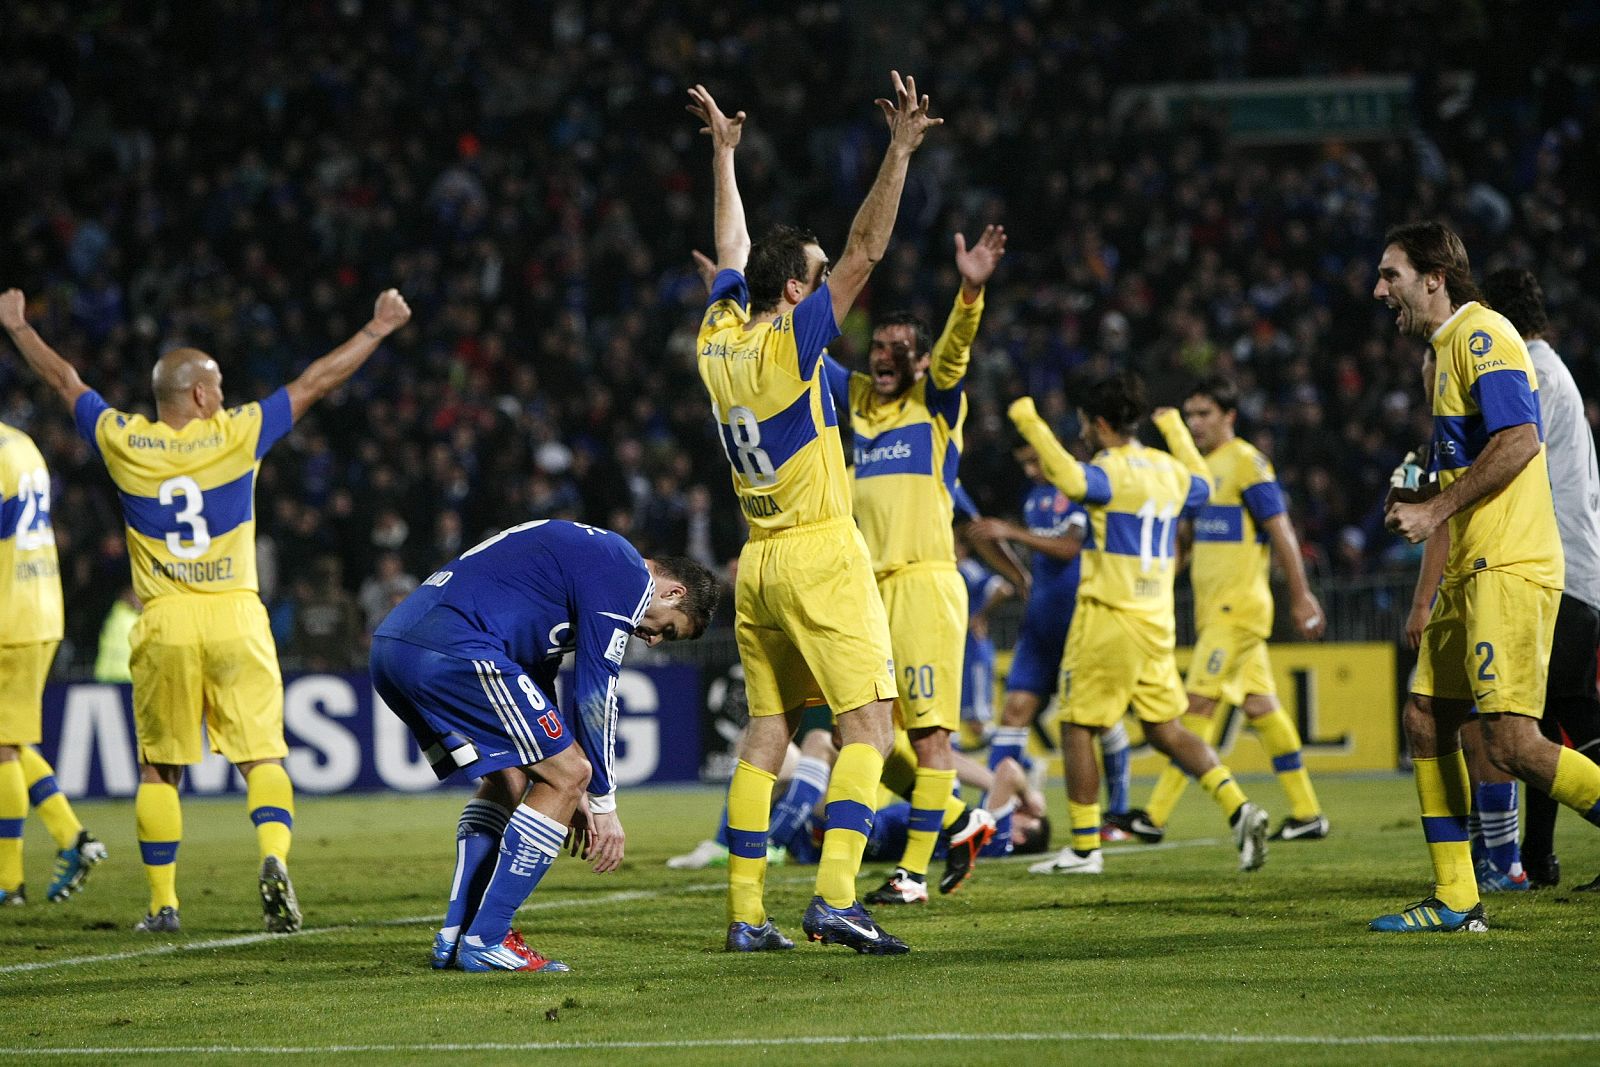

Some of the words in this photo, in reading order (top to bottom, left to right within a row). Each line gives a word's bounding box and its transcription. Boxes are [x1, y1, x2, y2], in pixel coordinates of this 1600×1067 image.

[1474, 359, 1507, 373] TOTAL
[128, 434, 166, 450] BBVA
[158, 474, 212, 560] 3
[1137, 499, 1175, 574] 11
[152, 558, 233, 583] RDRIGUEZ
[1207, 648, 1226, 676] 6
[1475, 641, 1496, 681] 2
[517, 674, 546, 711] 8
[904, 664, 935, 699] 20
[536, 709, 563, 740] U
